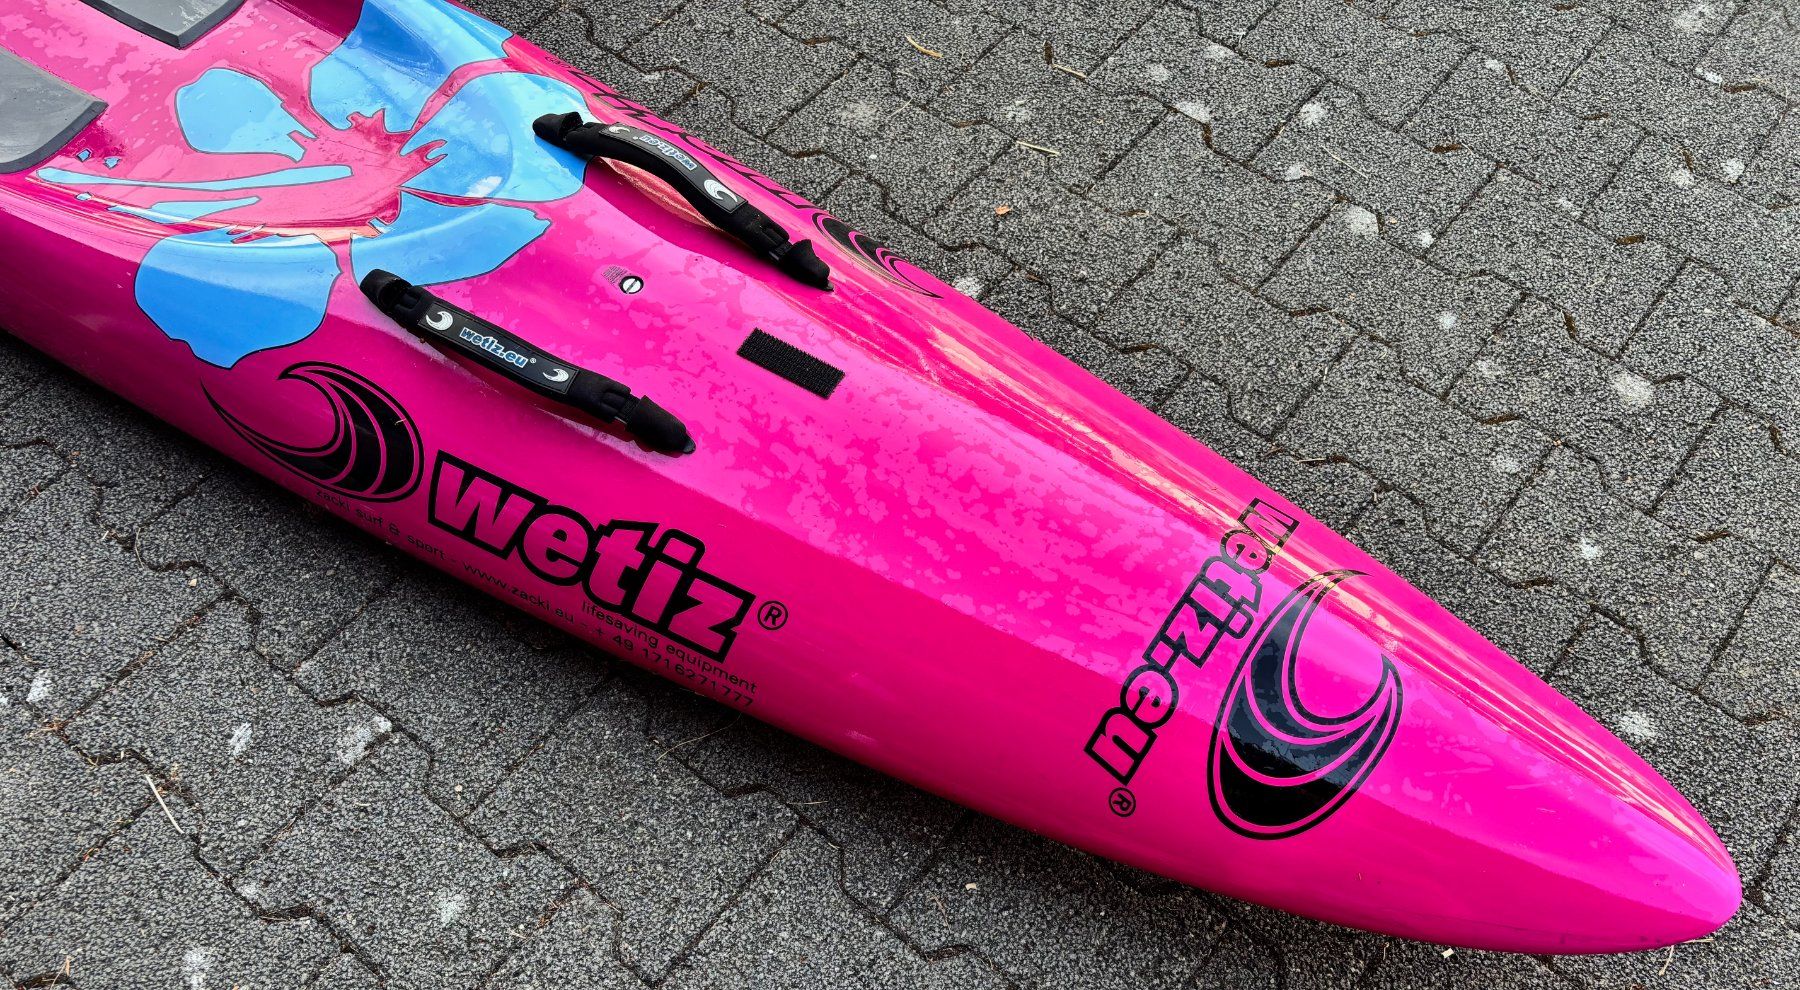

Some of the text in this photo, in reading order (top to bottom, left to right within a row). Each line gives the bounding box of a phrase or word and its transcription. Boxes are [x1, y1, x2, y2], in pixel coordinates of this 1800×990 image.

[459, 326, 529, 368] wetiz.eu
[355, 508, 384, 529] surf
[406, 534, 446, 561] sport
[428, 449, 757, 664] wetiz
[582, 601, 758, 695] lifesaving equipment
[1083, 497, 1301, 787] wetiz.eu
